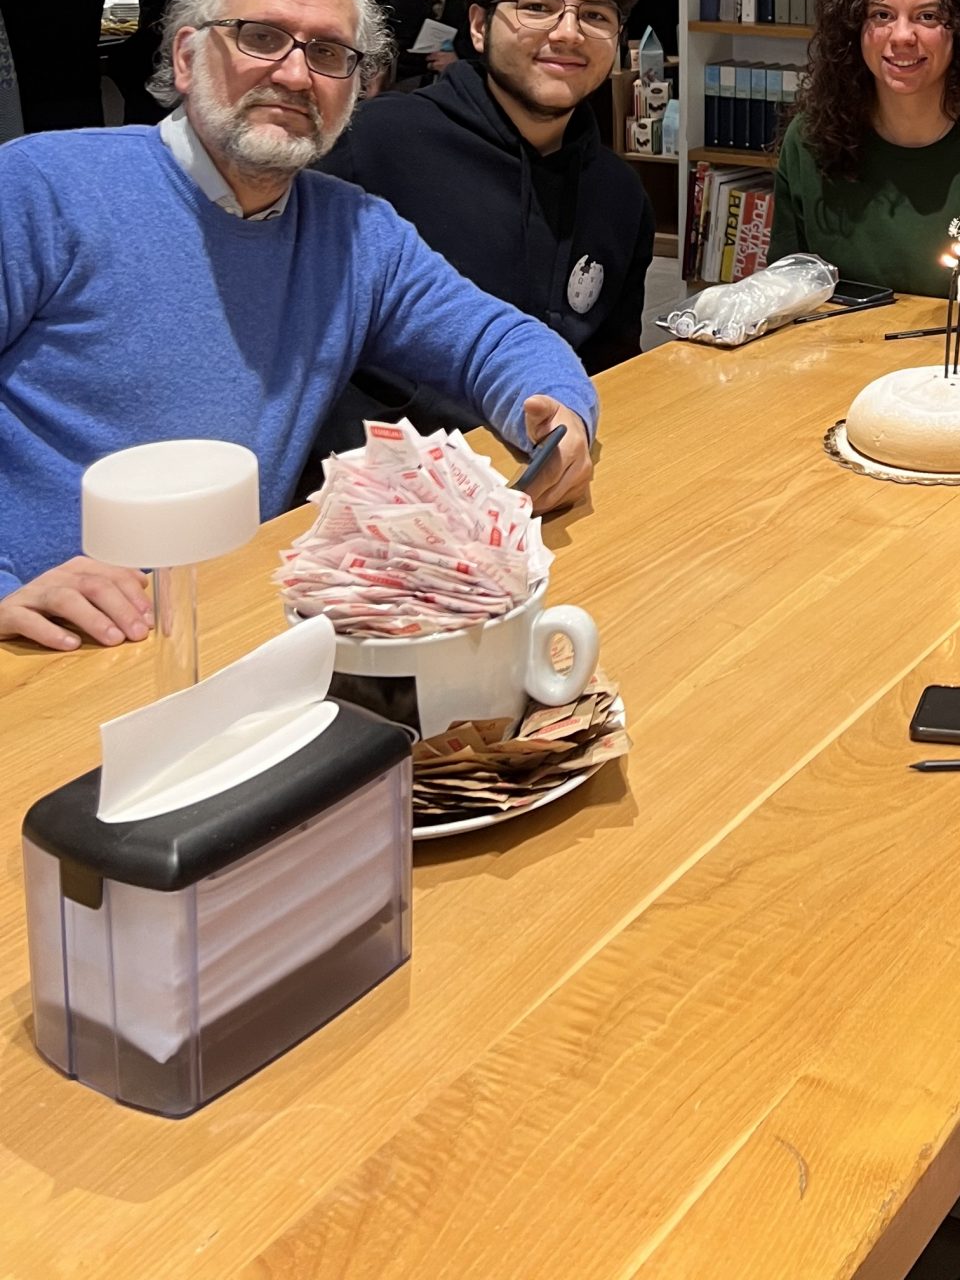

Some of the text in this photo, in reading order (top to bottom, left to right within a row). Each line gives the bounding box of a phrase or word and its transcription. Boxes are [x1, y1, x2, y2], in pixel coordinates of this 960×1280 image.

[724, 194, 741, 247] PUGLIA
[747, 199, 766, 253] PUGLIA
[734, 224, 751, 277] PUGLIA
